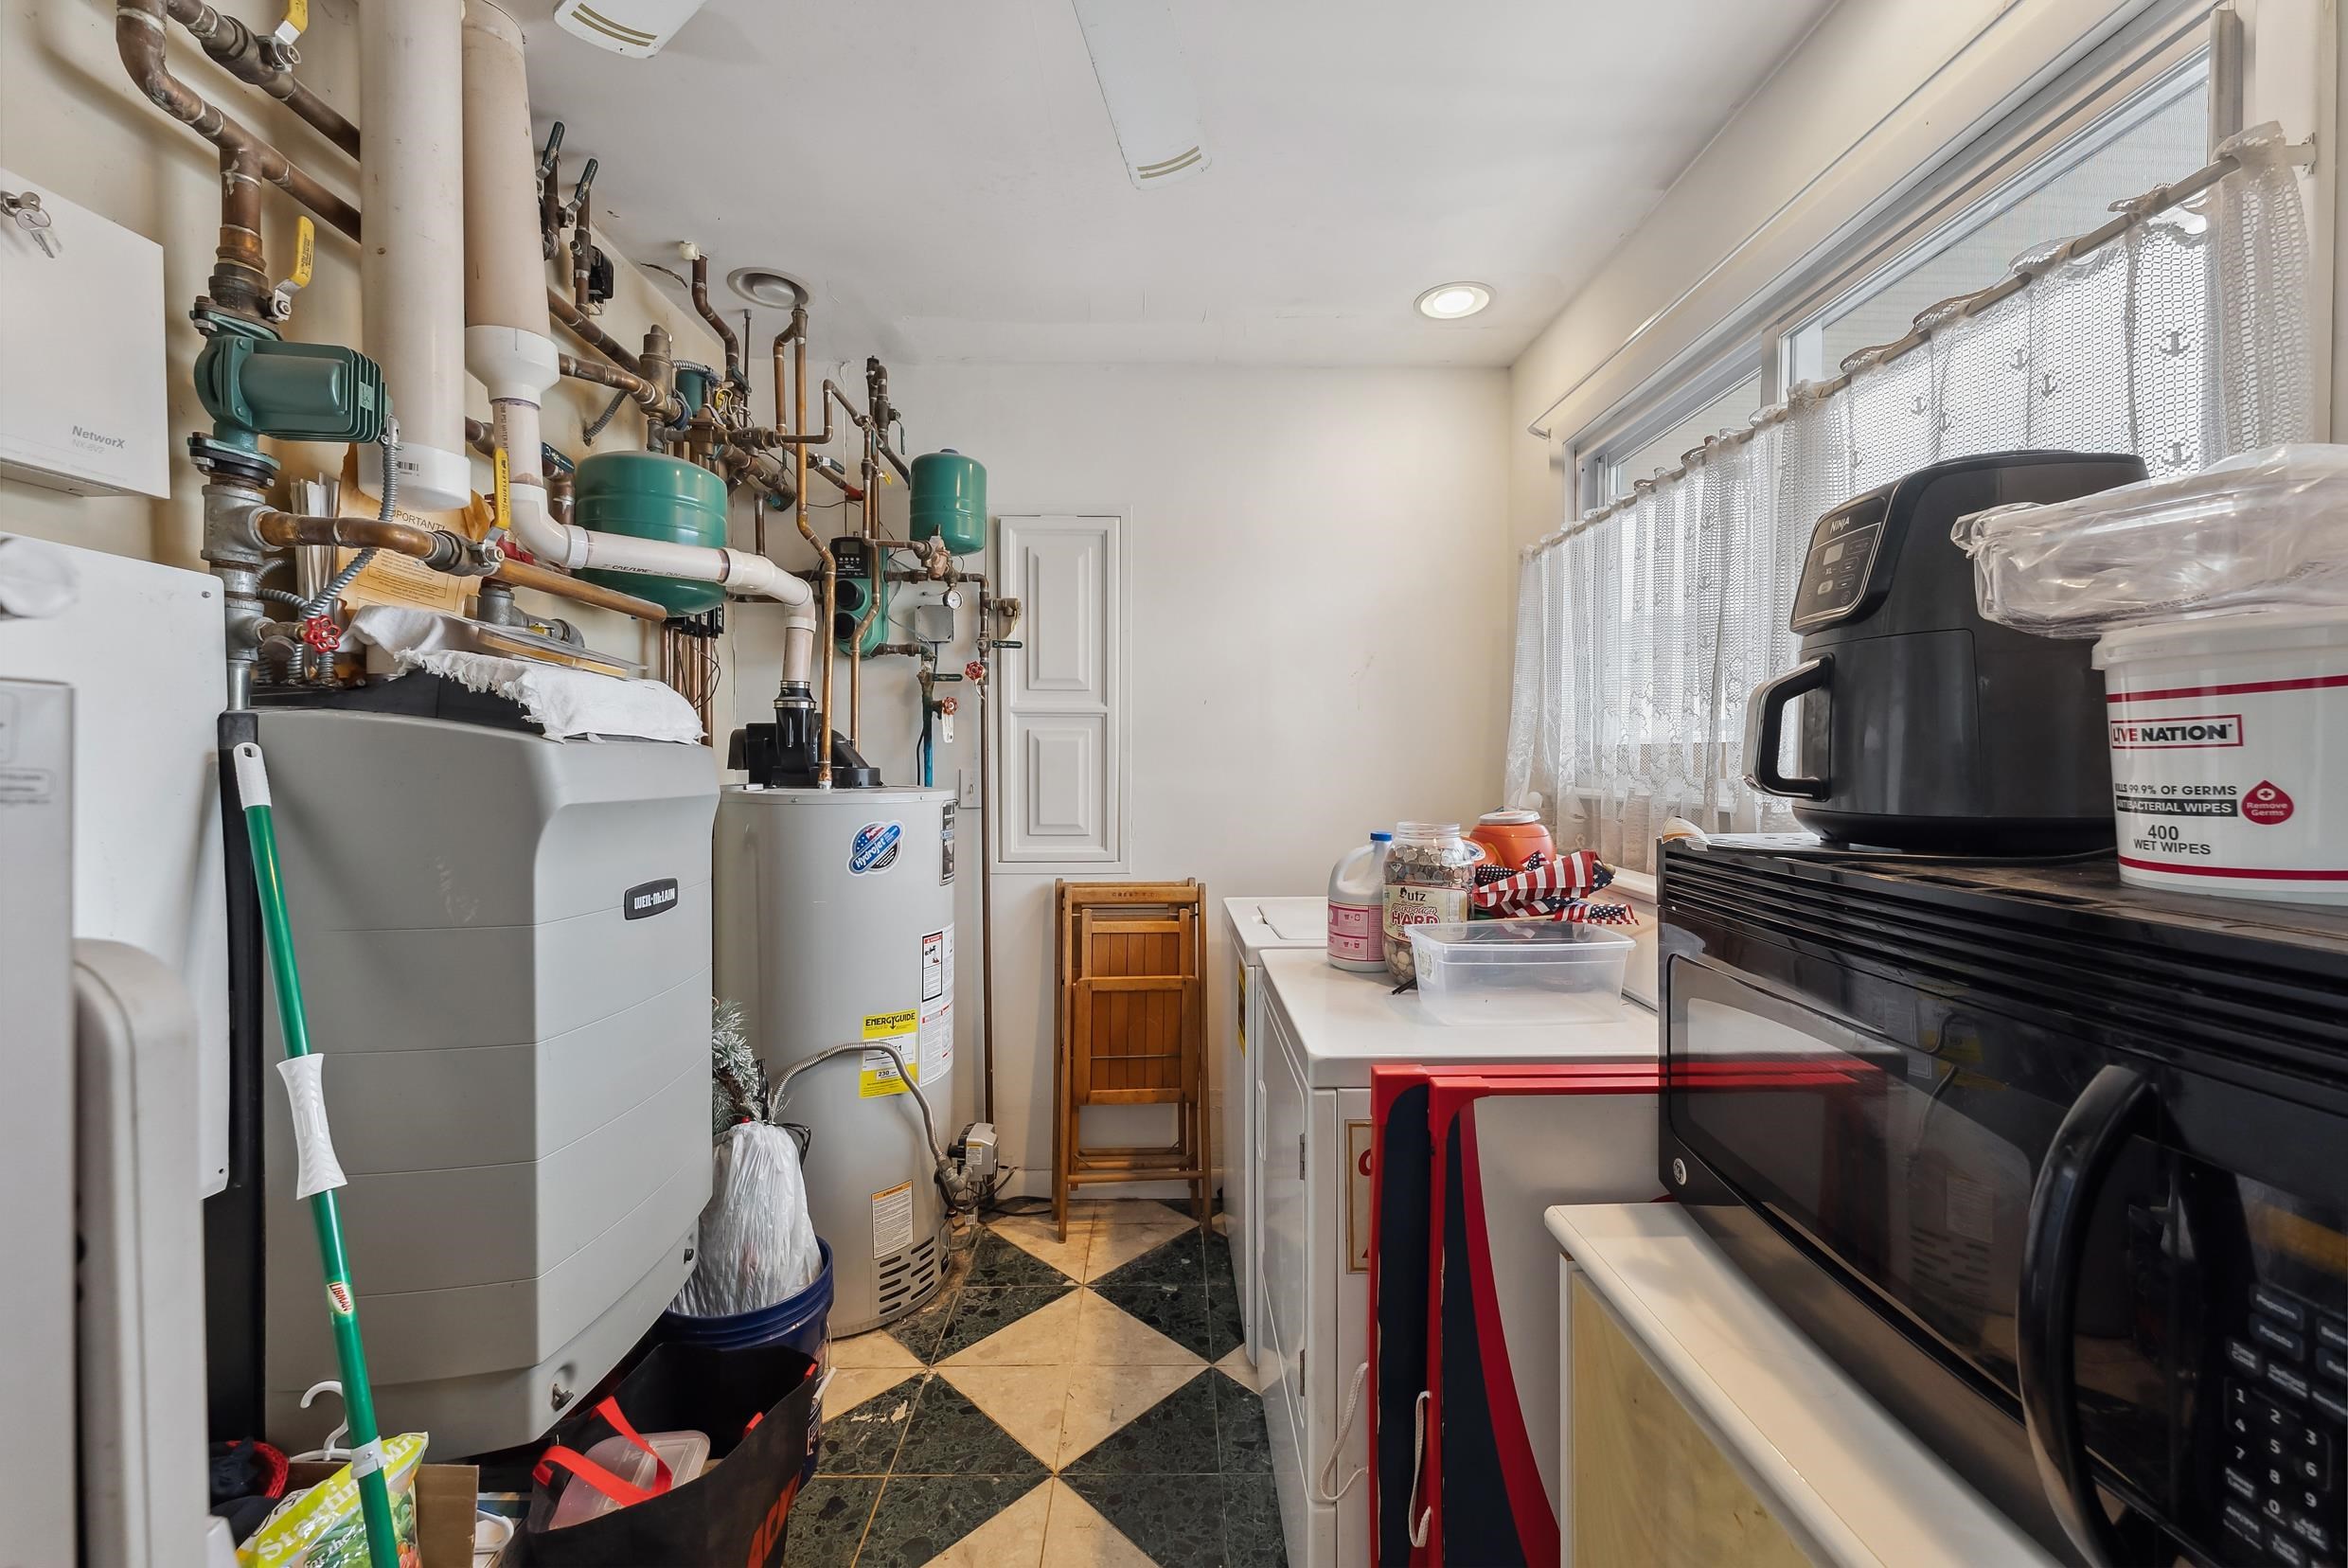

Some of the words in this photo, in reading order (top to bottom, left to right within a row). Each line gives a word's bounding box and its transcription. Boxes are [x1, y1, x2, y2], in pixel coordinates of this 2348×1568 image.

[72, 425, 125, 449] NetworX
[393, 508, 446, 531] PORTANT!
[1829, 516, 1850, 534] NINJA
[2112, 726, 2138, 743] LIVE
[2142, 723, 2229, 742] NATION
[2161, 785, 2179, 795] OF
[2181, 785, 2237, 796] GERMS
[2183, 802, 2232, 813] WIPES
[2250, 809, 2285, 817] Germs
[2147, 824, 2179, 841] 400
[2134, 839, 2157, 851] WET
[2161, 841, 2211, 855] WIPES
[2236, 1388, 2245, 1403] 1
[2270, 1408, 2281, 1424] 2
[2305, 1428, 2318, 1446] 3
[2234, 1418, 2246, 1432] 4
[2269, 1438, 2281, 1454] 5
[2304, 1461, 2318, 1477] 6
[2235, 1446, 2246, 1459] 7
[2269, 1469, 2281, 1485] 8
[2304, 1491, 2318, 1508] 9
[2268, 1499, 2281, 1515] 0
[258, 1478, 360, 1561] Startin
